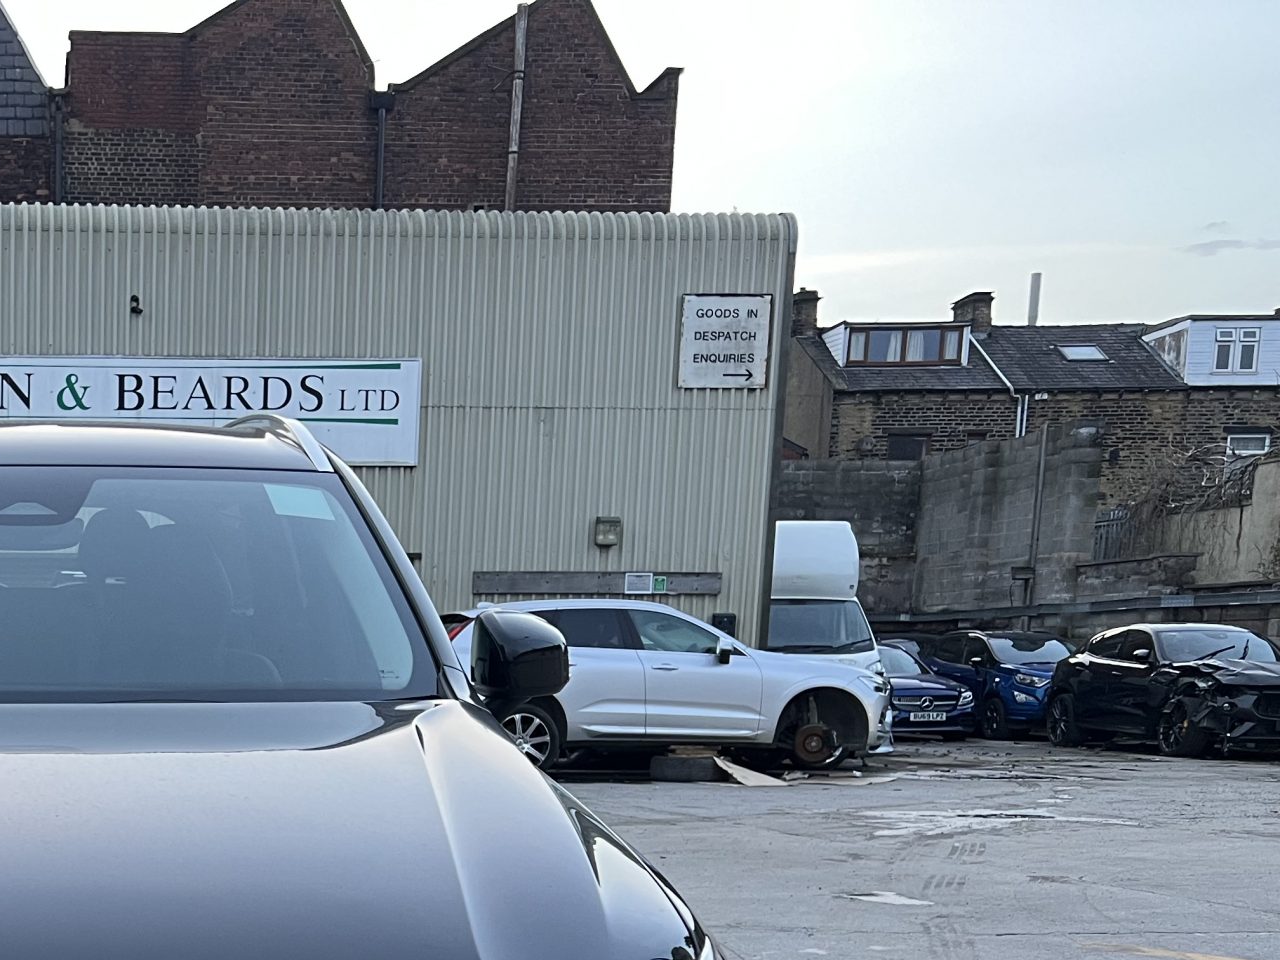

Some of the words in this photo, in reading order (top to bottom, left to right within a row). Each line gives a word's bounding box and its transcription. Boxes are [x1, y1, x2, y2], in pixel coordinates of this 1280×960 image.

[696, 308, 740, 319] GOODS
[747, 308, 758, 319] IN
[694, 331, 757, 341] DESPATCH
[693, 353, 755, 363] ENQUIRIES
[56, 373, 91, 411] &
[114, 373, 325, 412] BEARDS
[338, 389, 400, 412] LTD
